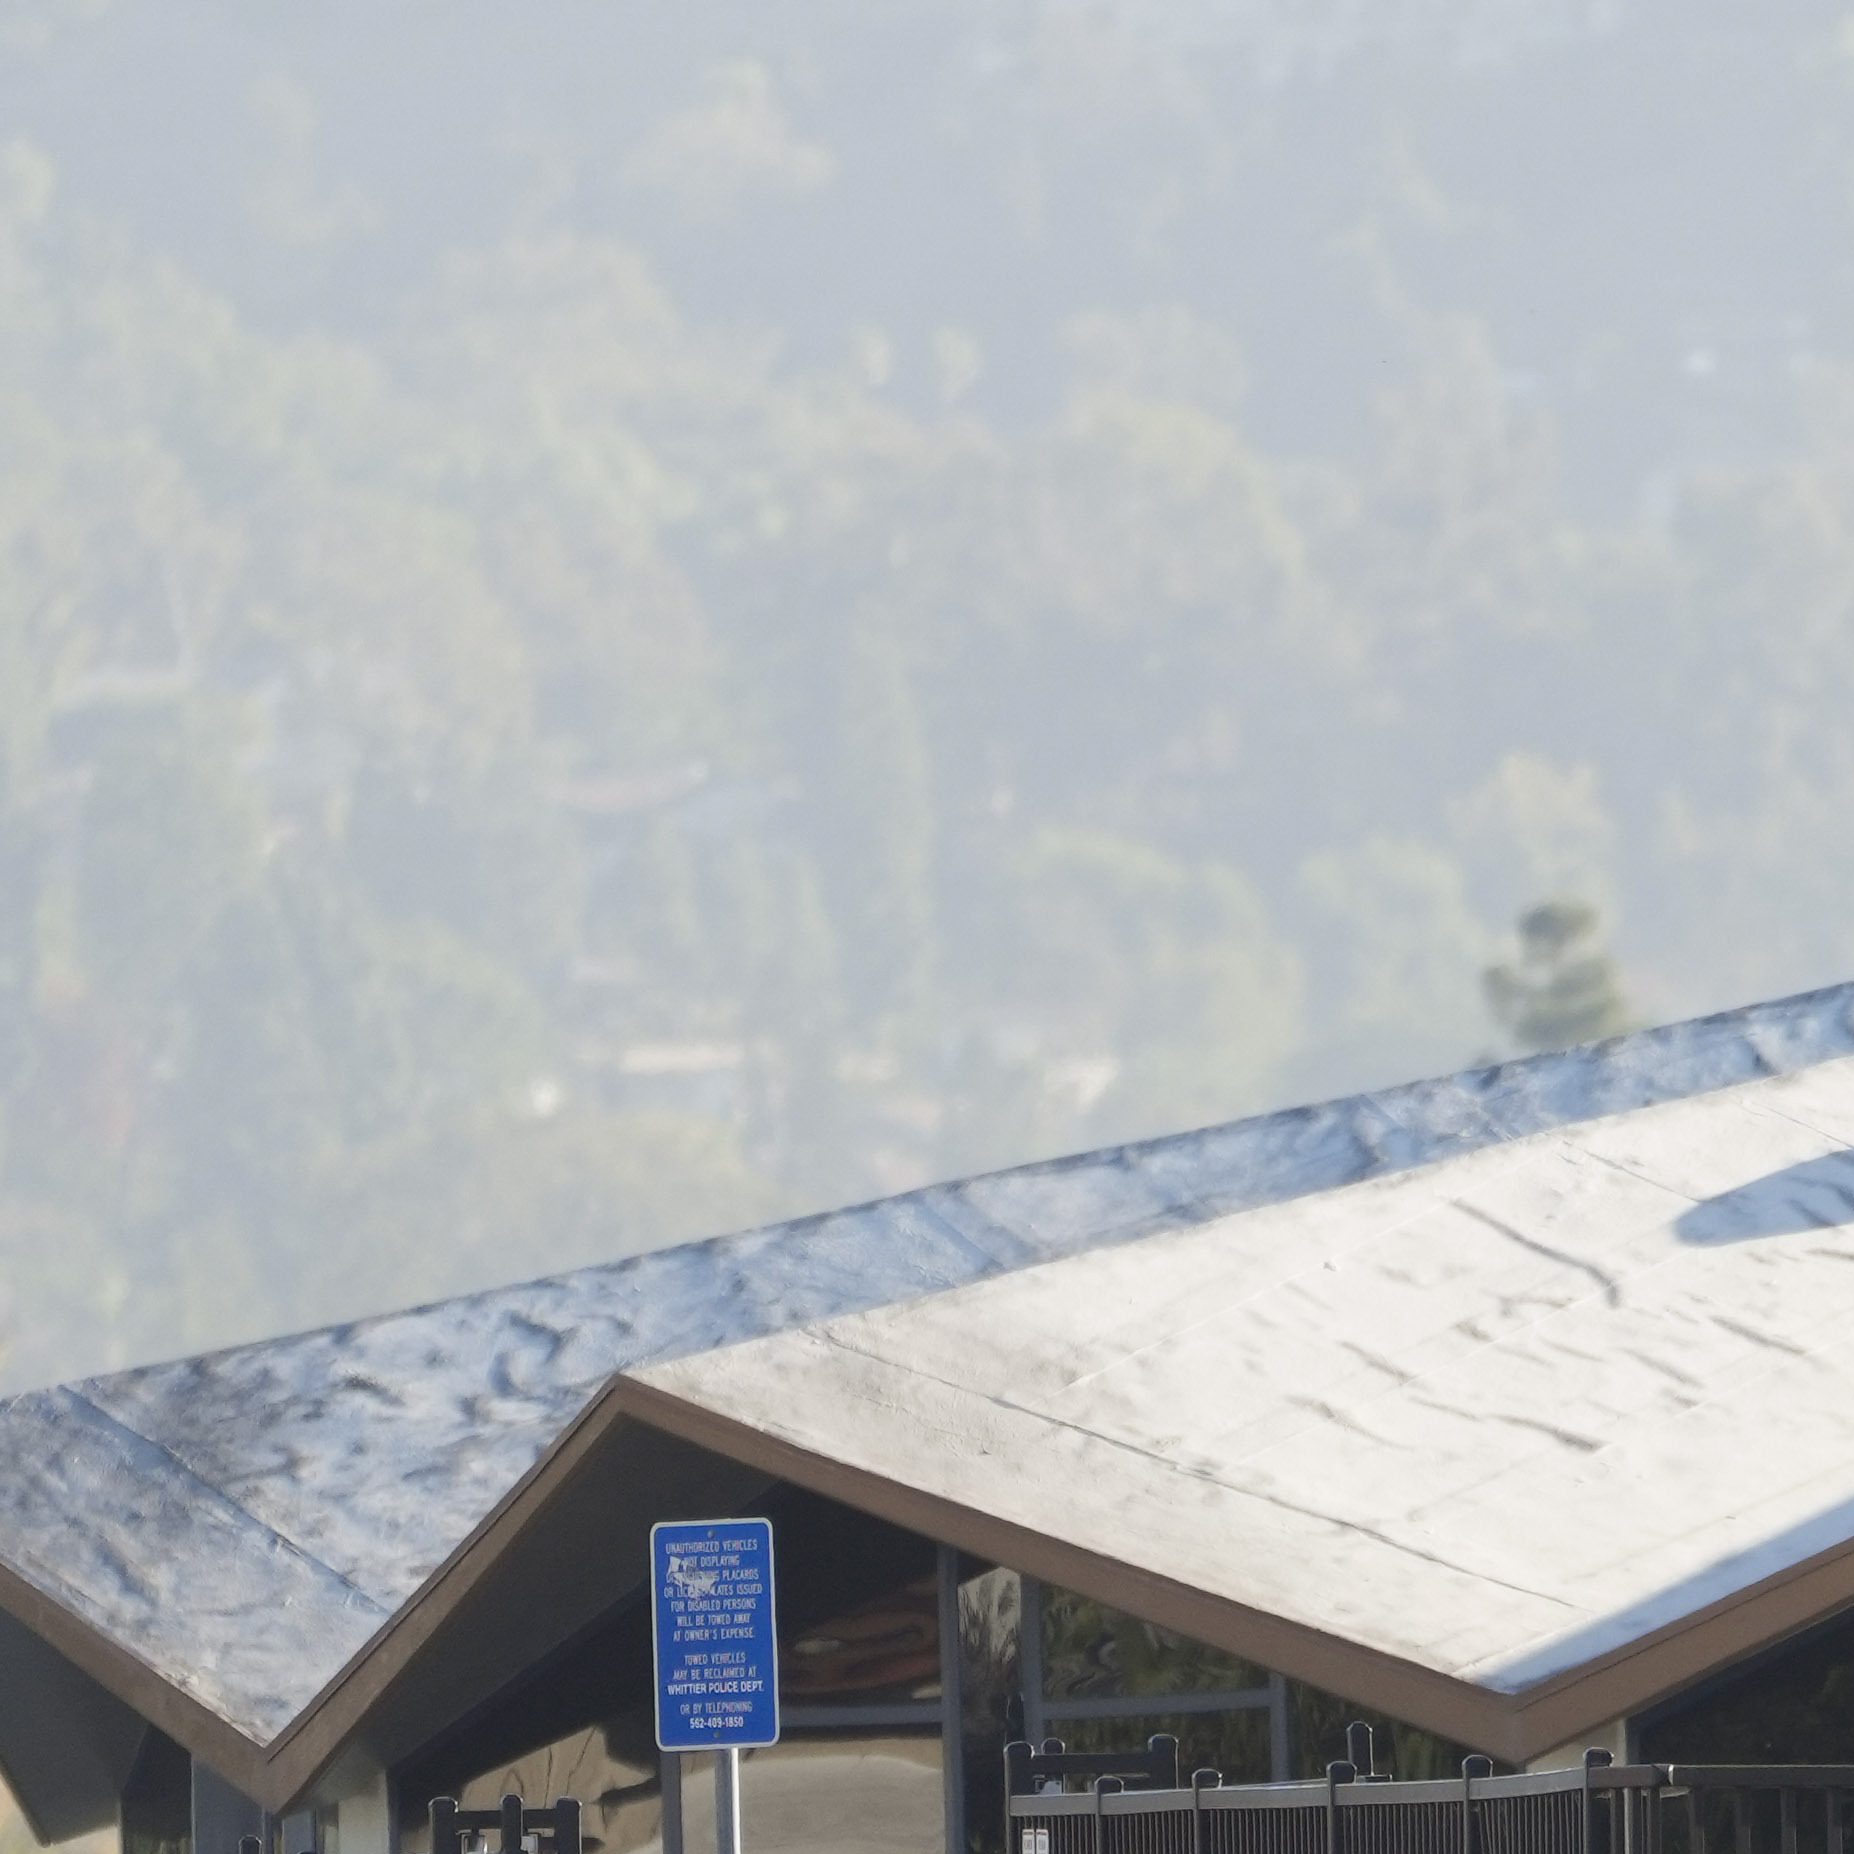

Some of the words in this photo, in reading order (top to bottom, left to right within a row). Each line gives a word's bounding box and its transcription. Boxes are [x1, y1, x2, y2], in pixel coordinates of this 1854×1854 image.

[665, 1541, 720, 1554] UNAUTHORIZED
[723, 1539, 758, 1551] VEHICLES
[700, 1554, 740, 1567] DISPLAYING
[722, 1568, 760, 1581] PLACARDS
[663, 1587, 674, 1598] OR
[711, 1584, 734, 1597] LATES
[736, 1583, 763, 1595] ISSUED
[670, 1601, 686, 1612] FOR
[687, 1599, 721, 1612] DISABLED
[723, 1598, 757, 1610] PERSONS
[676, 1615, 693, 1627] WILL
[695, 1614, 705, 1626] BE
[708, 1613, 731, 1625] TOWED
[733, 1612, 752, 1624] AWAY
[673, 1630, 682, 1642] AT
[684, 1628, 718, 1641] OWNER'S
[684, 1653, 708, 1666] TOWED
[711, 1651, 746, 1664] VEHICLES
[672, 1669, 688, 1681] MAY
[690, 1668, 701, 1680] BE
[703, 1666, 745, 1680] RECLAIMED
[747, 1666, 757, 1678] AT
[667, 1683, 707, 1696] WHITTIER
[708, 1681, 739, 1694] POLICE
[680, 1704, 691, 1716] OR
[692, 1703, 702, 1715] BY
[705, 1701, 753, 1714] TELEPHONING
